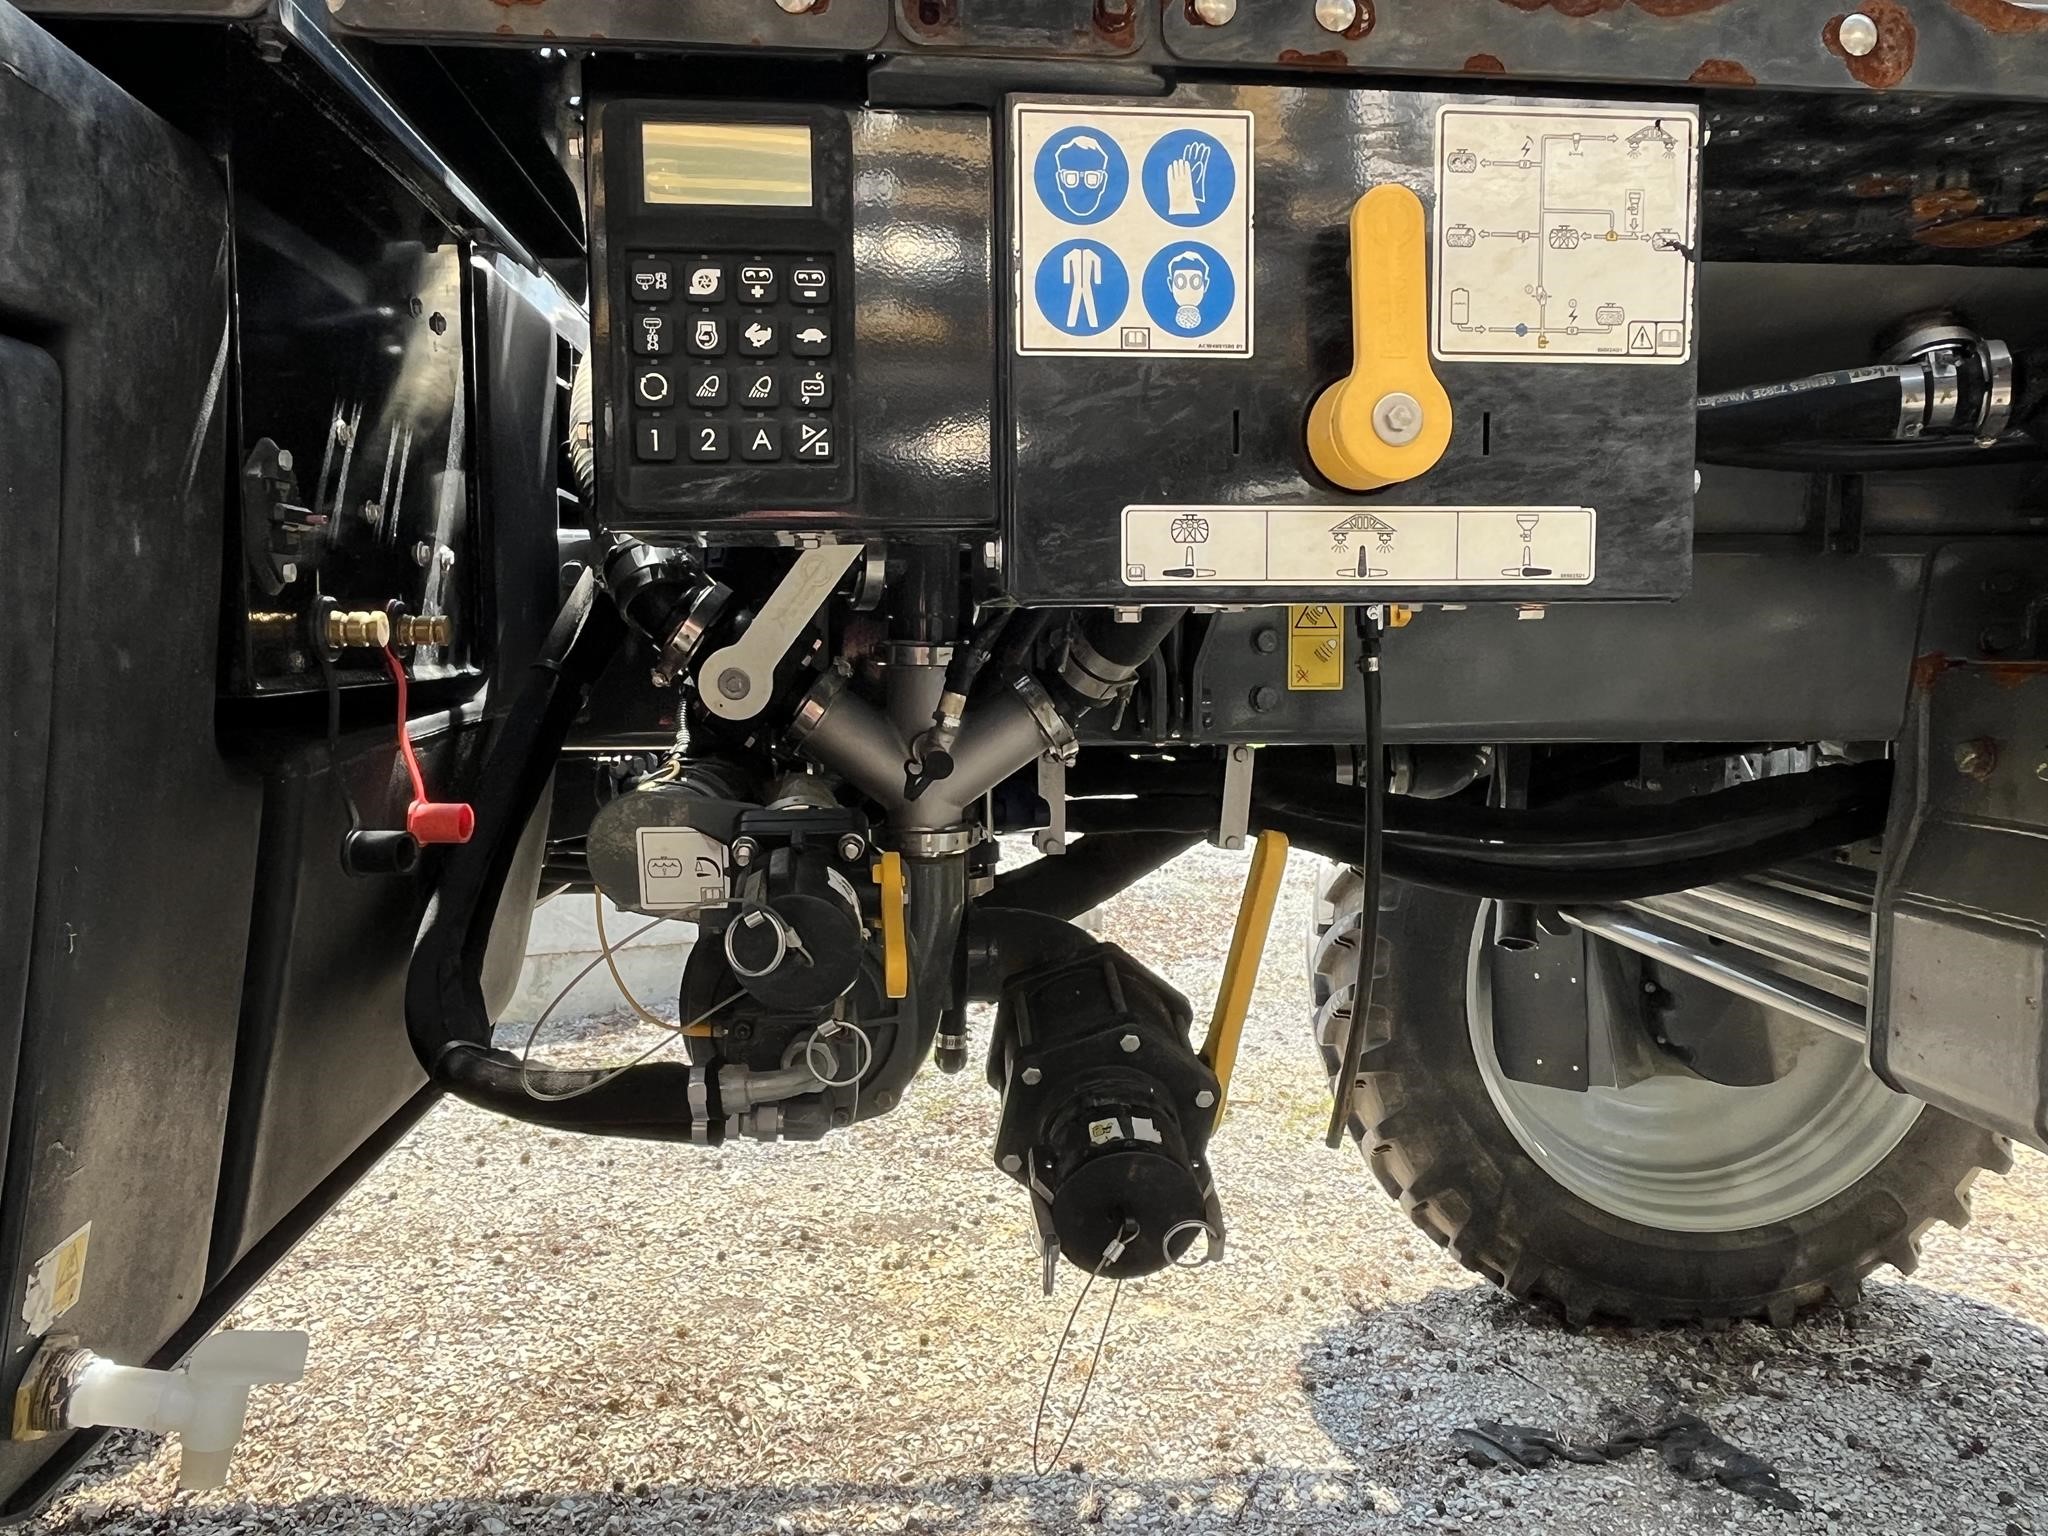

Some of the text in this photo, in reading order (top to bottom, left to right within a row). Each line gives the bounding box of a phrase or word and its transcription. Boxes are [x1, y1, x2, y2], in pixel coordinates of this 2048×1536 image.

[650, 428, 659, 452] 1
[701, 428, 716, 451] 2
[752, 428, 772, 451] A
